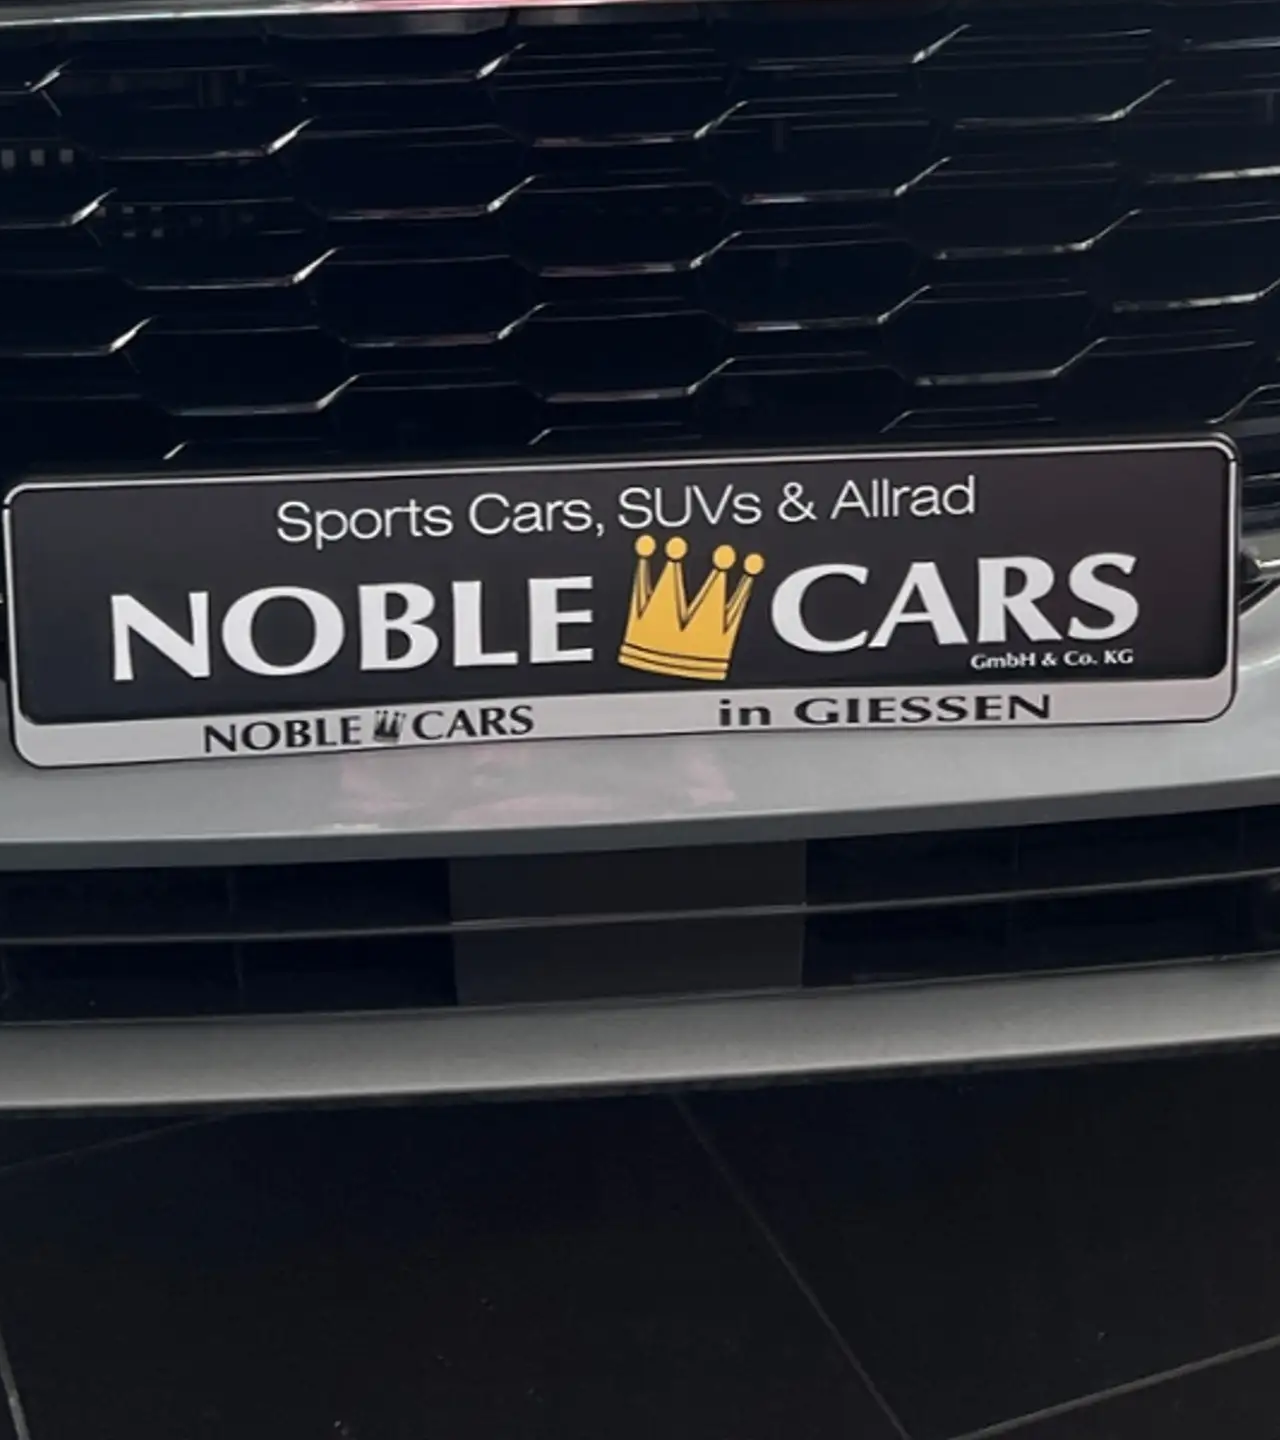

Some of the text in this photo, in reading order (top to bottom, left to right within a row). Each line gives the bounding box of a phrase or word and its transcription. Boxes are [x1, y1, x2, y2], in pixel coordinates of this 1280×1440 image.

[276, 475, 976, 550] Sports Cars, SUVs & Allrad
[110, 552, 1139, 681] NOBLE CARS
[970, 648, 1134, 670] GmbH & Co. KG
[204, 694, 1051, 754] NOBLE CARS in GIESSEN
